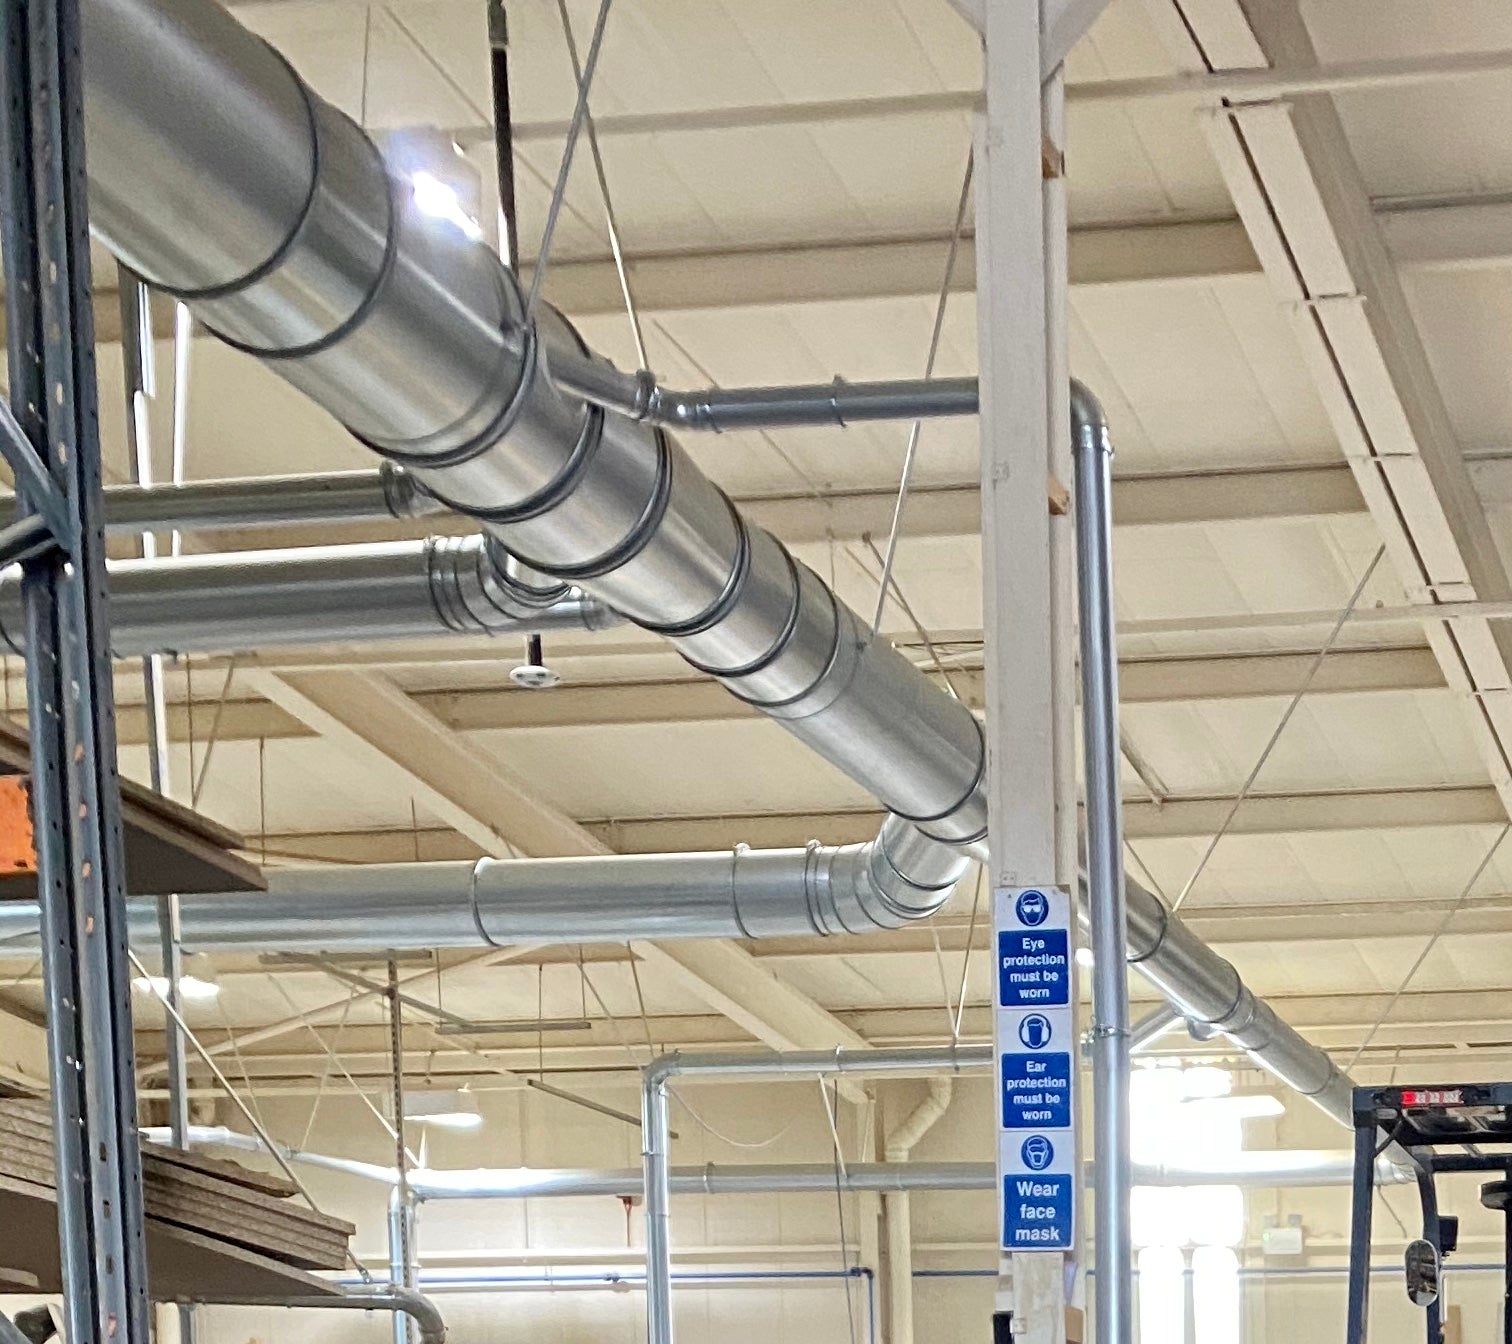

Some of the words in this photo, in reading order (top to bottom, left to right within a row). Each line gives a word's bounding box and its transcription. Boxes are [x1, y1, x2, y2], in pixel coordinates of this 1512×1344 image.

[1022, 937, 1045, 952] Eye
[1003, 953, 1065, 969] protection
[1010, 970, 1041, 983] must
[1043, 969, 1059, 982] be
[1018, 988, 1050, 999] worn
[1026, 1060, 1047, 1073] Ear
[1006, 1075, 1067, 1091] protection
[1013, 1093, 1043, 1105] must
[1045, 1092, 1061, 1104] be
[1022, 1110, 1052, 1120] worn
[1016, 1180, 1060, 1197] Wear
[1020, 1203, 1056, 1219] face
[1015, 1226, 1060, 1241] mask
